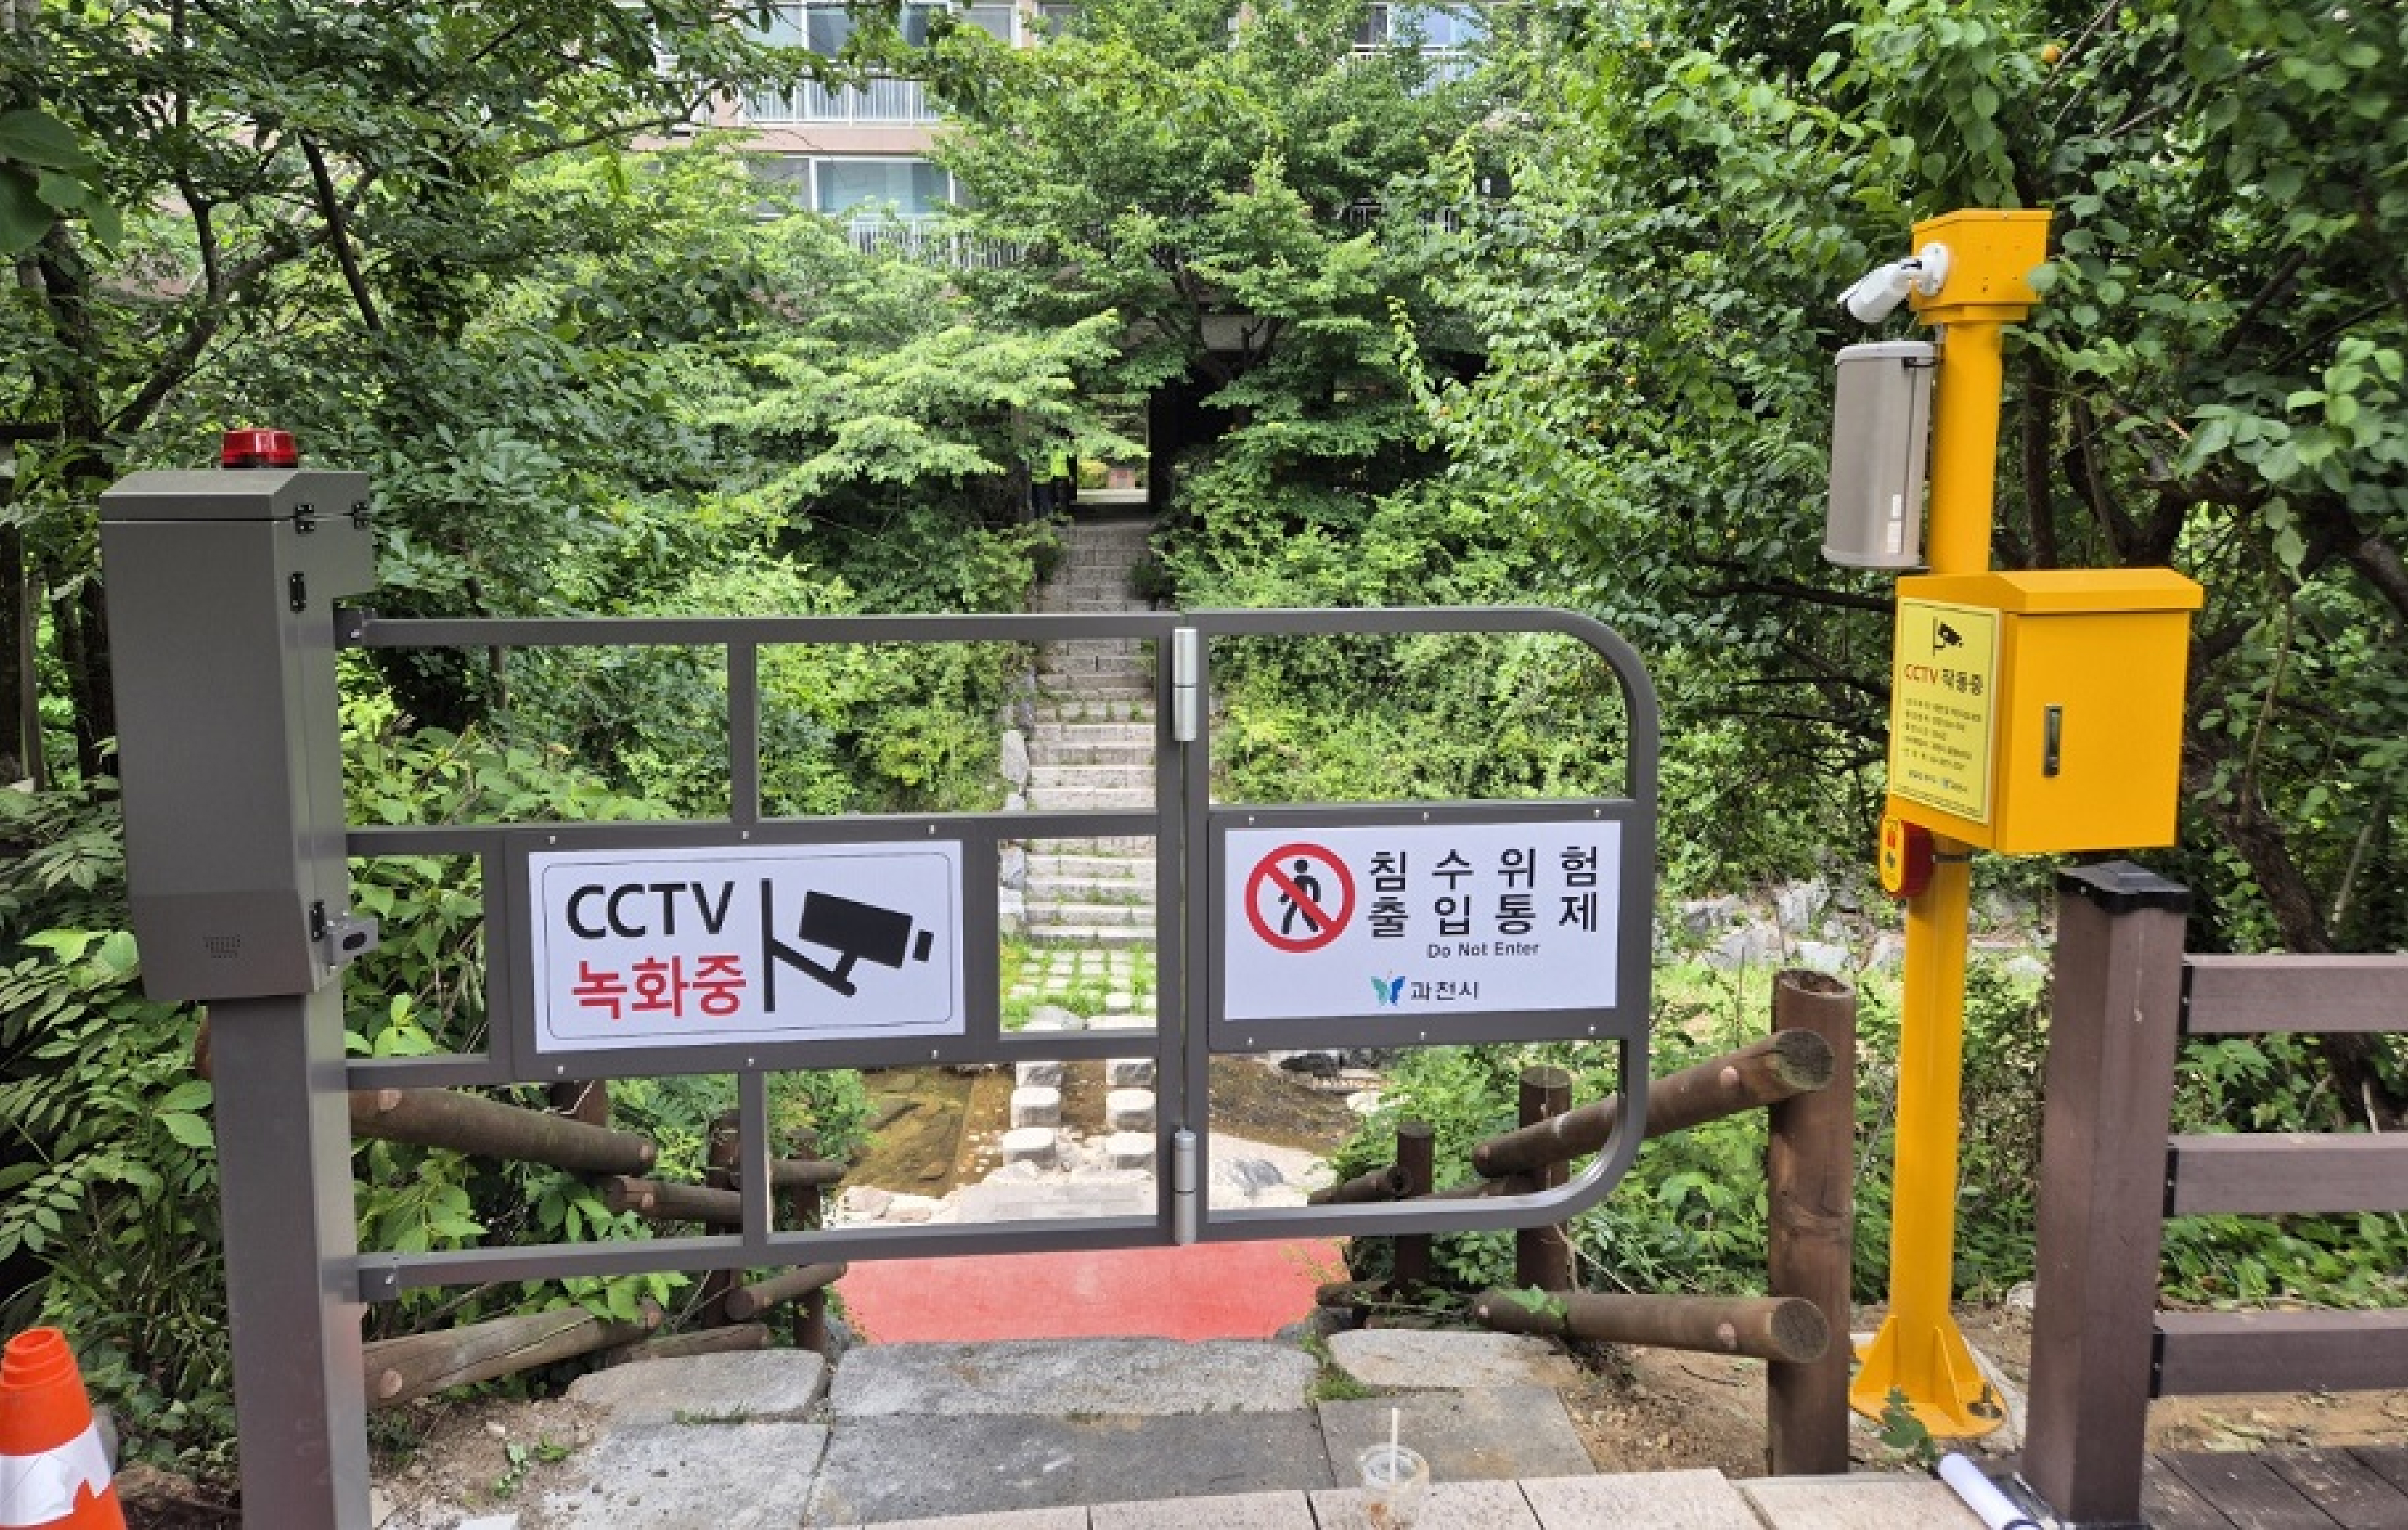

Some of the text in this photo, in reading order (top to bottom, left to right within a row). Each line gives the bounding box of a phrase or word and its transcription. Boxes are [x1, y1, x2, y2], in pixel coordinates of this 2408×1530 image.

[1368, 845, 1598, 892] 침수위험
[565, 881, 736, 940] CCTV
[1368, 891, 1598, 939] 출입통제
[1427, 941, 1541, 959] Do Not Enter
[570, 955, 747, 1020] 녹화중
[1410, 980, 1480, 1001] 과천시
